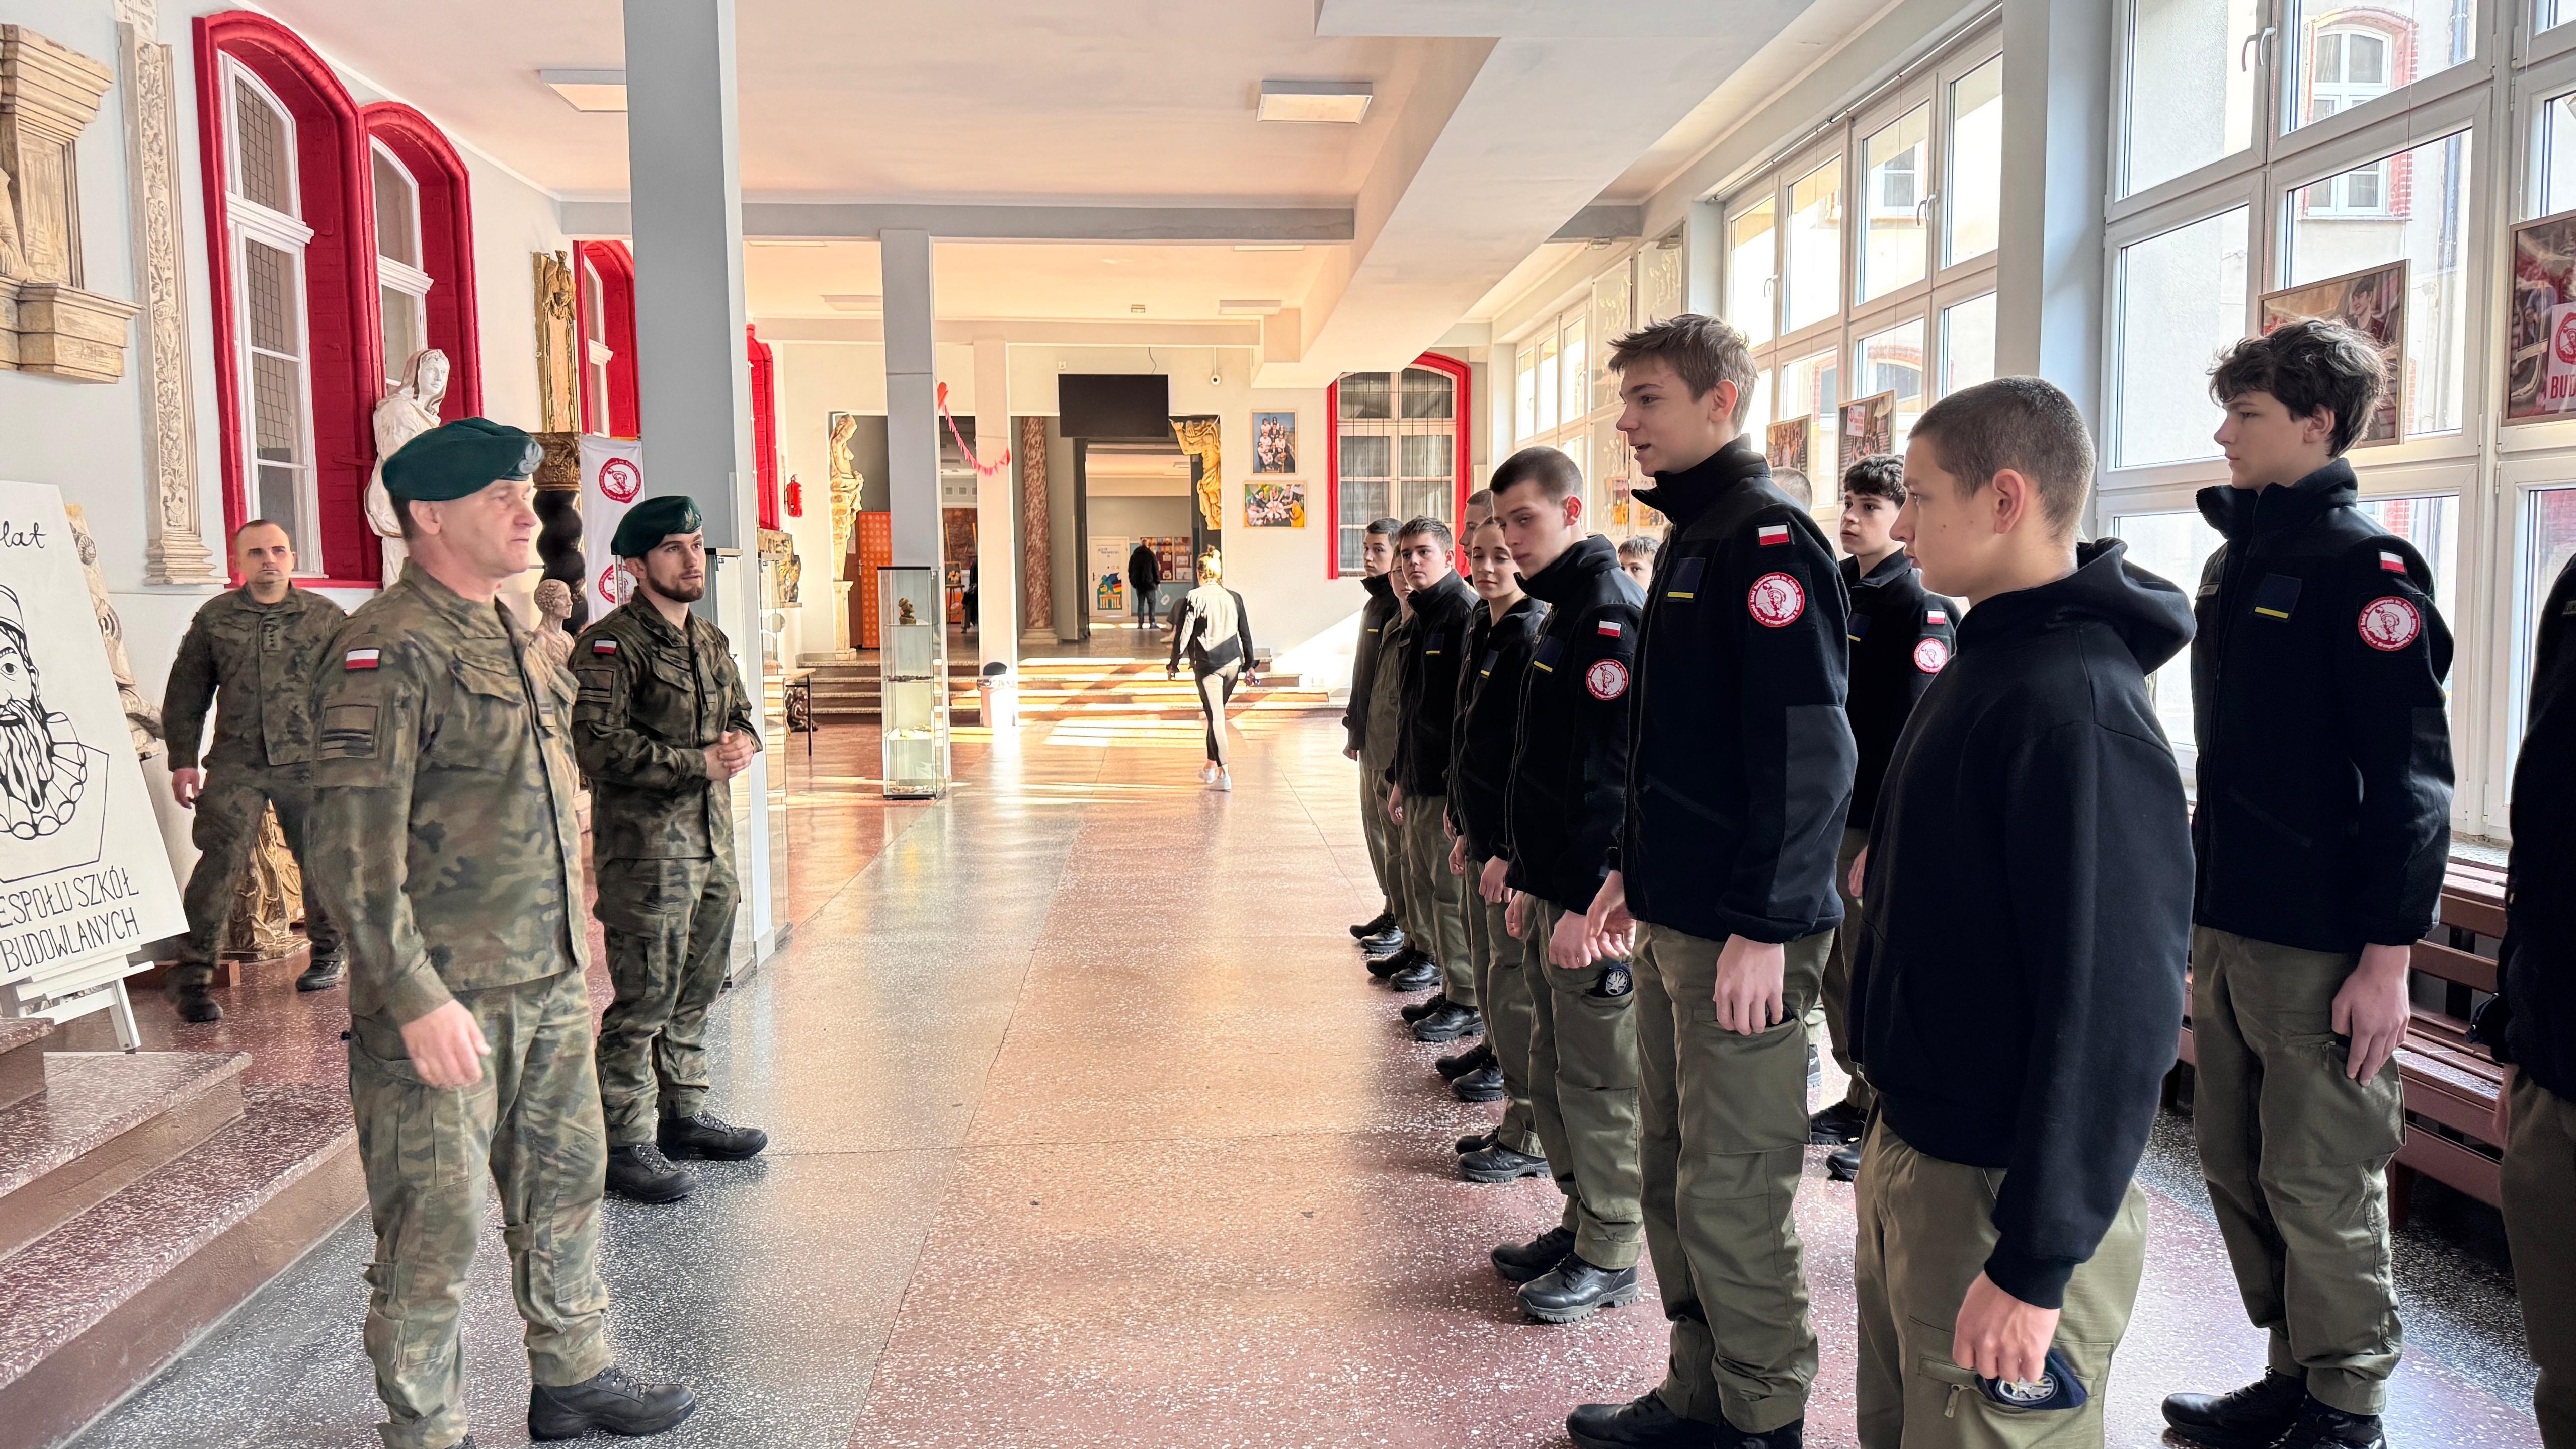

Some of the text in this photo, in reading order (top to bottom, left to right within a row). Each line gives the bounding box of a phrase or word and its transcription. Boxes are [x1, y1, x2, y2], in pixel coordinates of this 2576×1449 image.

[0, 520, 47, 548] lat
[73, 865, 139, 907] SZKÓŁ
[0, 907, 140, 973] BUDOWLANYCH
